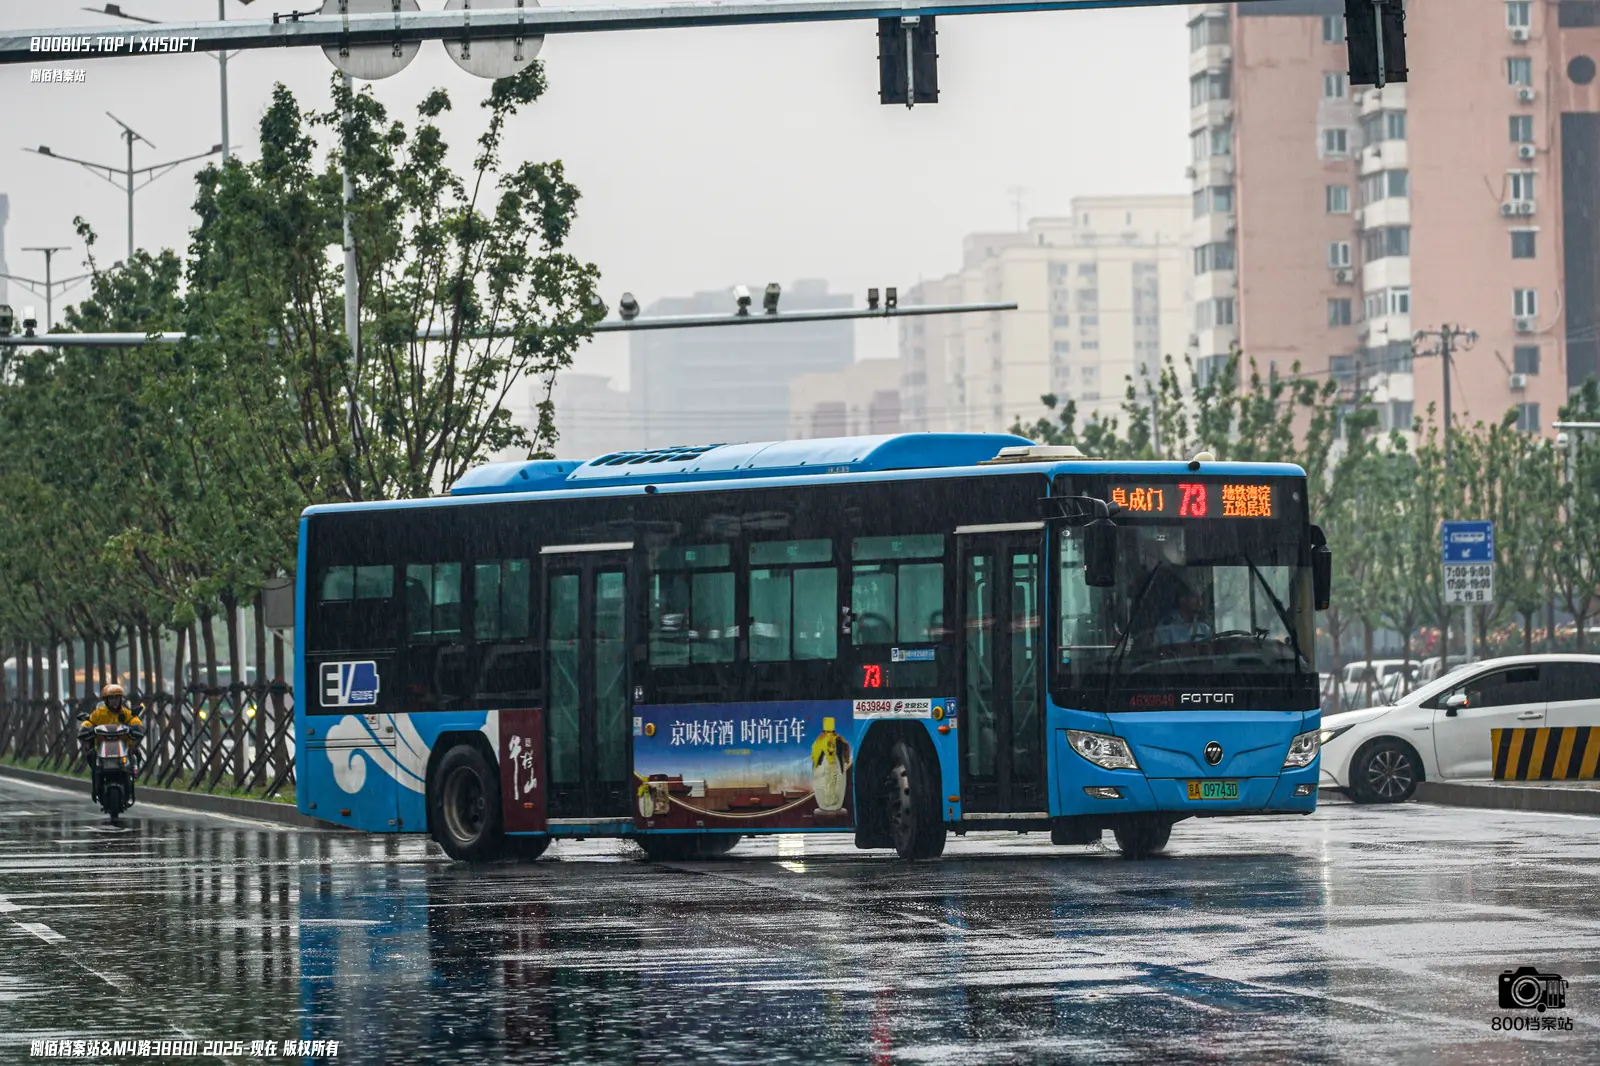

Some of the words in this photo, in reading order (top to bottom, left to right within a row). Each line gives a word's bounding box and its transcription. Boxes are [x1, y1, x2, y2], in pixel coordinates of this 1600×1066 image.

[1178, 484, 1207, 516] 73
[1222, 485, 1271, 500] 地铁海淀
[1223, 500, 1272, 516] 五路居站
[1446, 578, 1491, 590] 17:00-19:00
[1453, 590, 1484, 602] 工作日
[862, 663, 881, 689] 73
[1180, 693, 1234, 704] FOTON
[856, 701, 892, 712] 4639849
[669, 719, 734, 746] 京味好酒
[740, 717, 806, 745] 时尚百年
